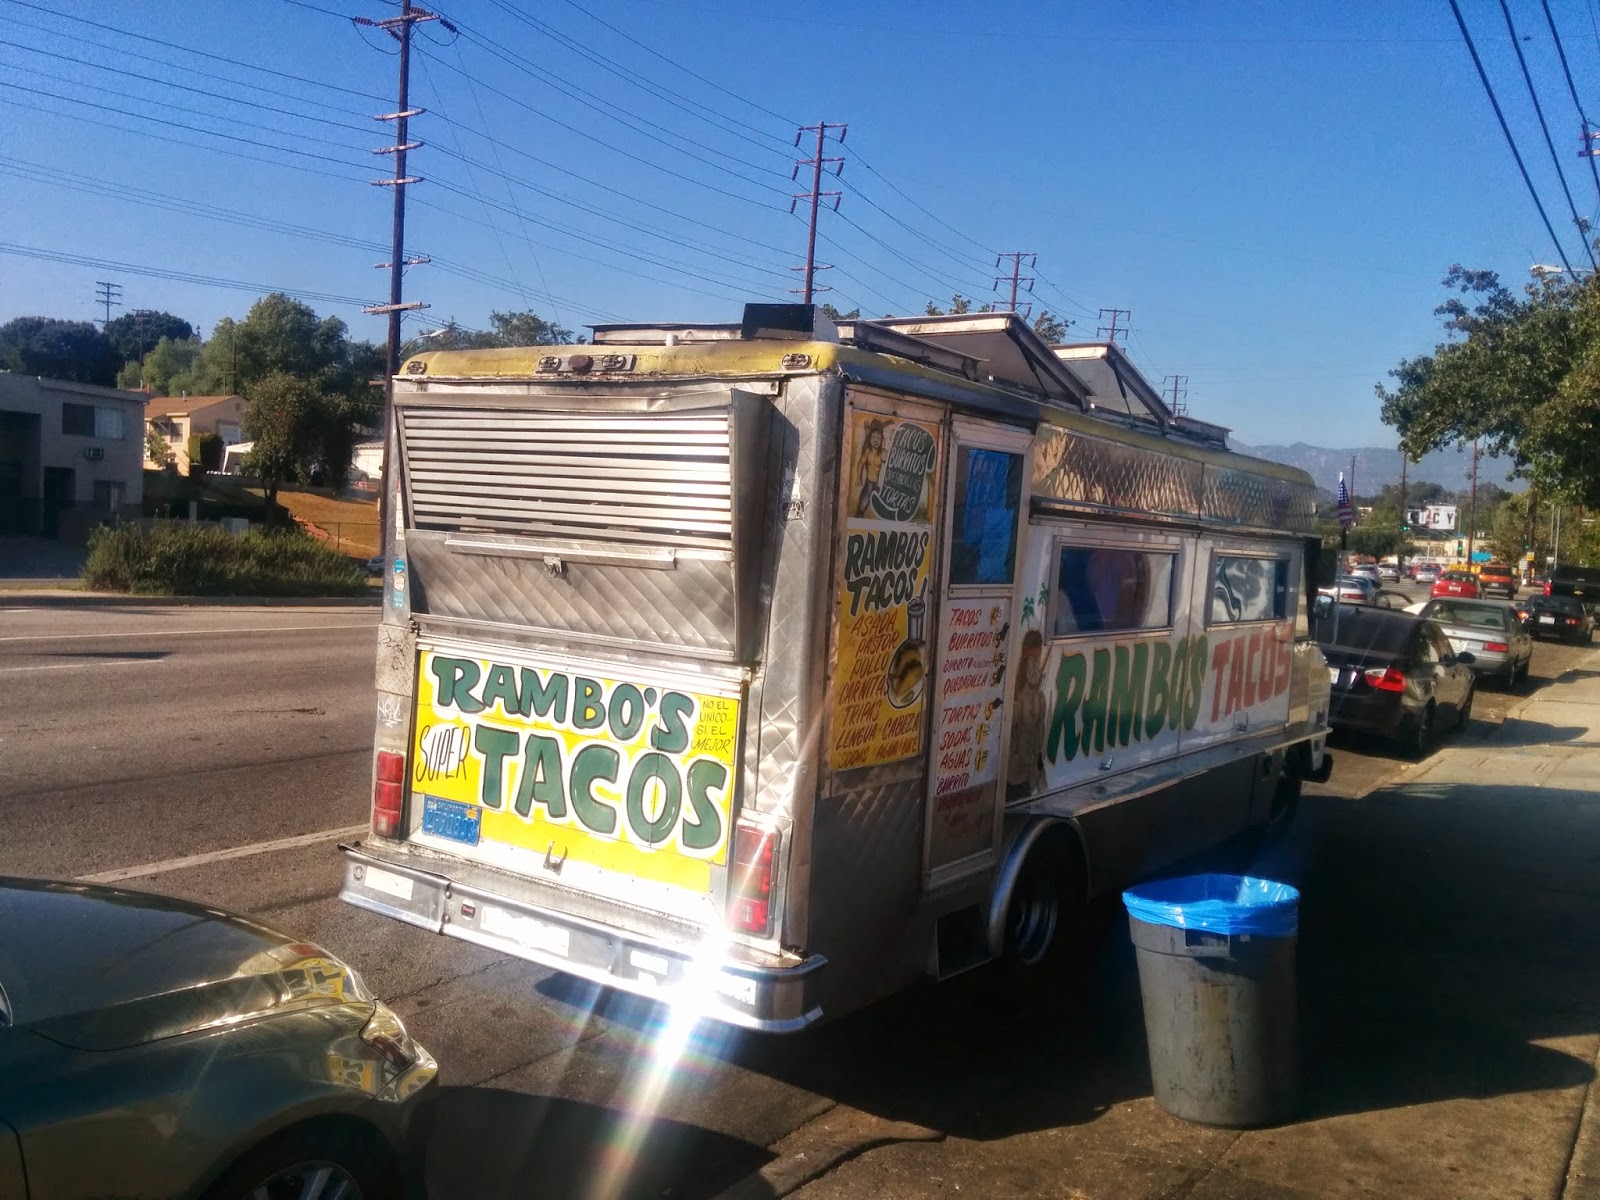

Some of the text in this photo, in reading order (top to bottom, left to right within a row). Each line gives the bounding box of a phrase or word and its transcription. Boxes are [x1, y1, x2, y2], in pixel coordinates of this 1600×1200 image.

[896, 426, 927, 454] TACOS
[888, 447, 926, 476] BURRITOS
[882, 485, 917, 514] TORTAS
[844, 531, 930, 581] RAMBOS
[847, 567, 918, 617] TACOS
[850, 608, 899, 638] ASADA
[950, 607, 983, 627] TACOS
[855, 631, 899, 655] PASTOR
[948, 631, 994, 652] BURRITOS
[850, 651, 890, 682] POLLO
[943, 656, 973, 673] BURRITO
[1211, 622, 1295, 724] TACOS
[943, 671, 989, 699] QUESADILLA
[432, 656, 694, 754] RAMBO'S
[716, 700, 730, 710] EL
[841, 700, 882, 729] TRIPAS
[942, 702, 982, 725] TORTAS
[711, 725, 727, 736] EL
[835, 712, 920, 751] LENGUA CABEZA
[940, 725, 973, 751] SODAS
[415, 724, 472, 783] SUPER
[838, 747, 870, 769] SODAS
[940, 747, 973, 771] AGUAS
[474, 723, 728, 850] TACOS
[936, 773, 970, 796] BURRITO
